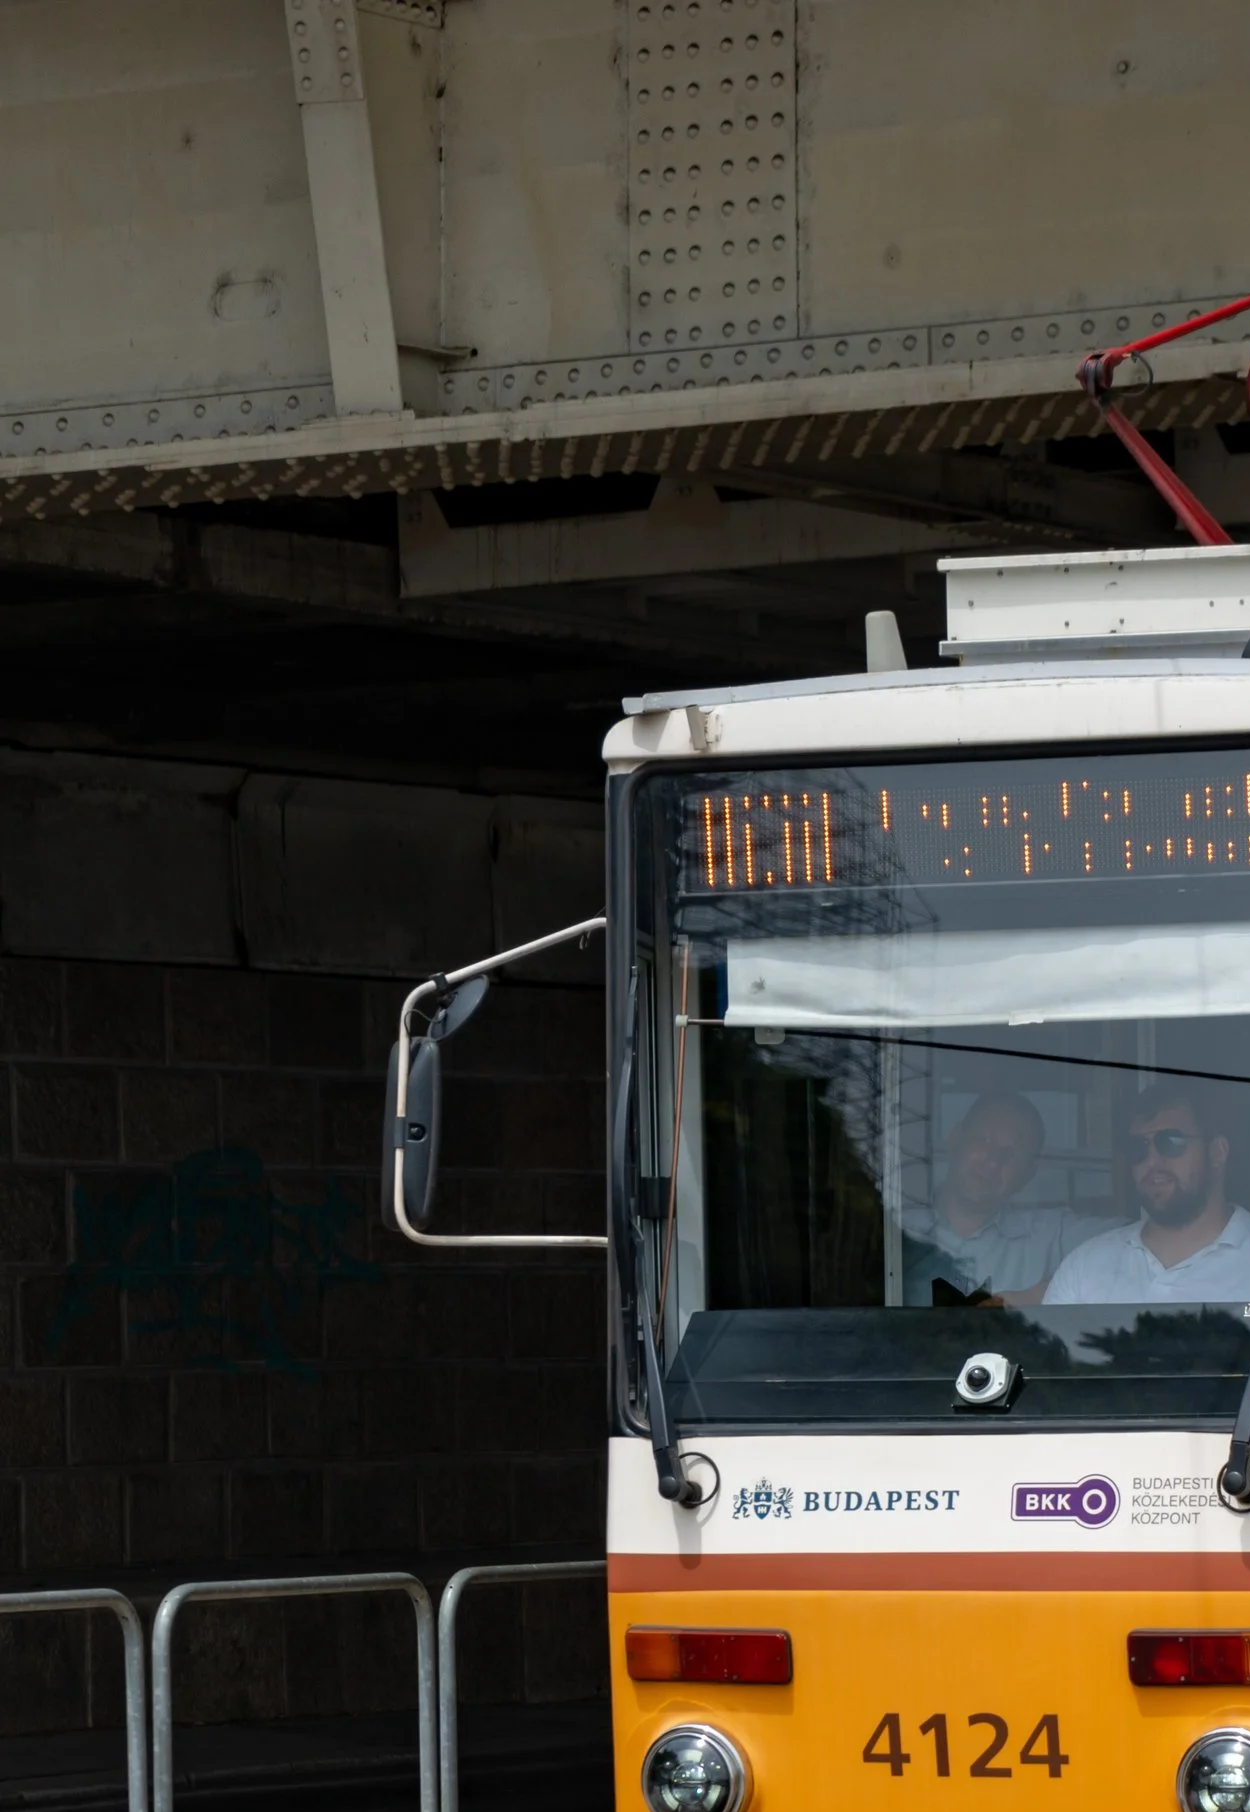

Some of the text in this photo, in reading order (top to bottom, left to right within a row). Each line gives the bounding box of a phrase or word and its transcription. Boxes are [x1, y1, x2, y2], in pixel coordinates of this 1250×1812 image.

[1132, 1477, 1214, 1490] BUDAPESTI
[803, 1490, 960, 1512] BUDAPEST
[1025, 1493, 1072, 1511] BKK
[1131, 1510, 1201, 1525] KÖZPONT
[862, 1712, 1070, 1779] 4124
